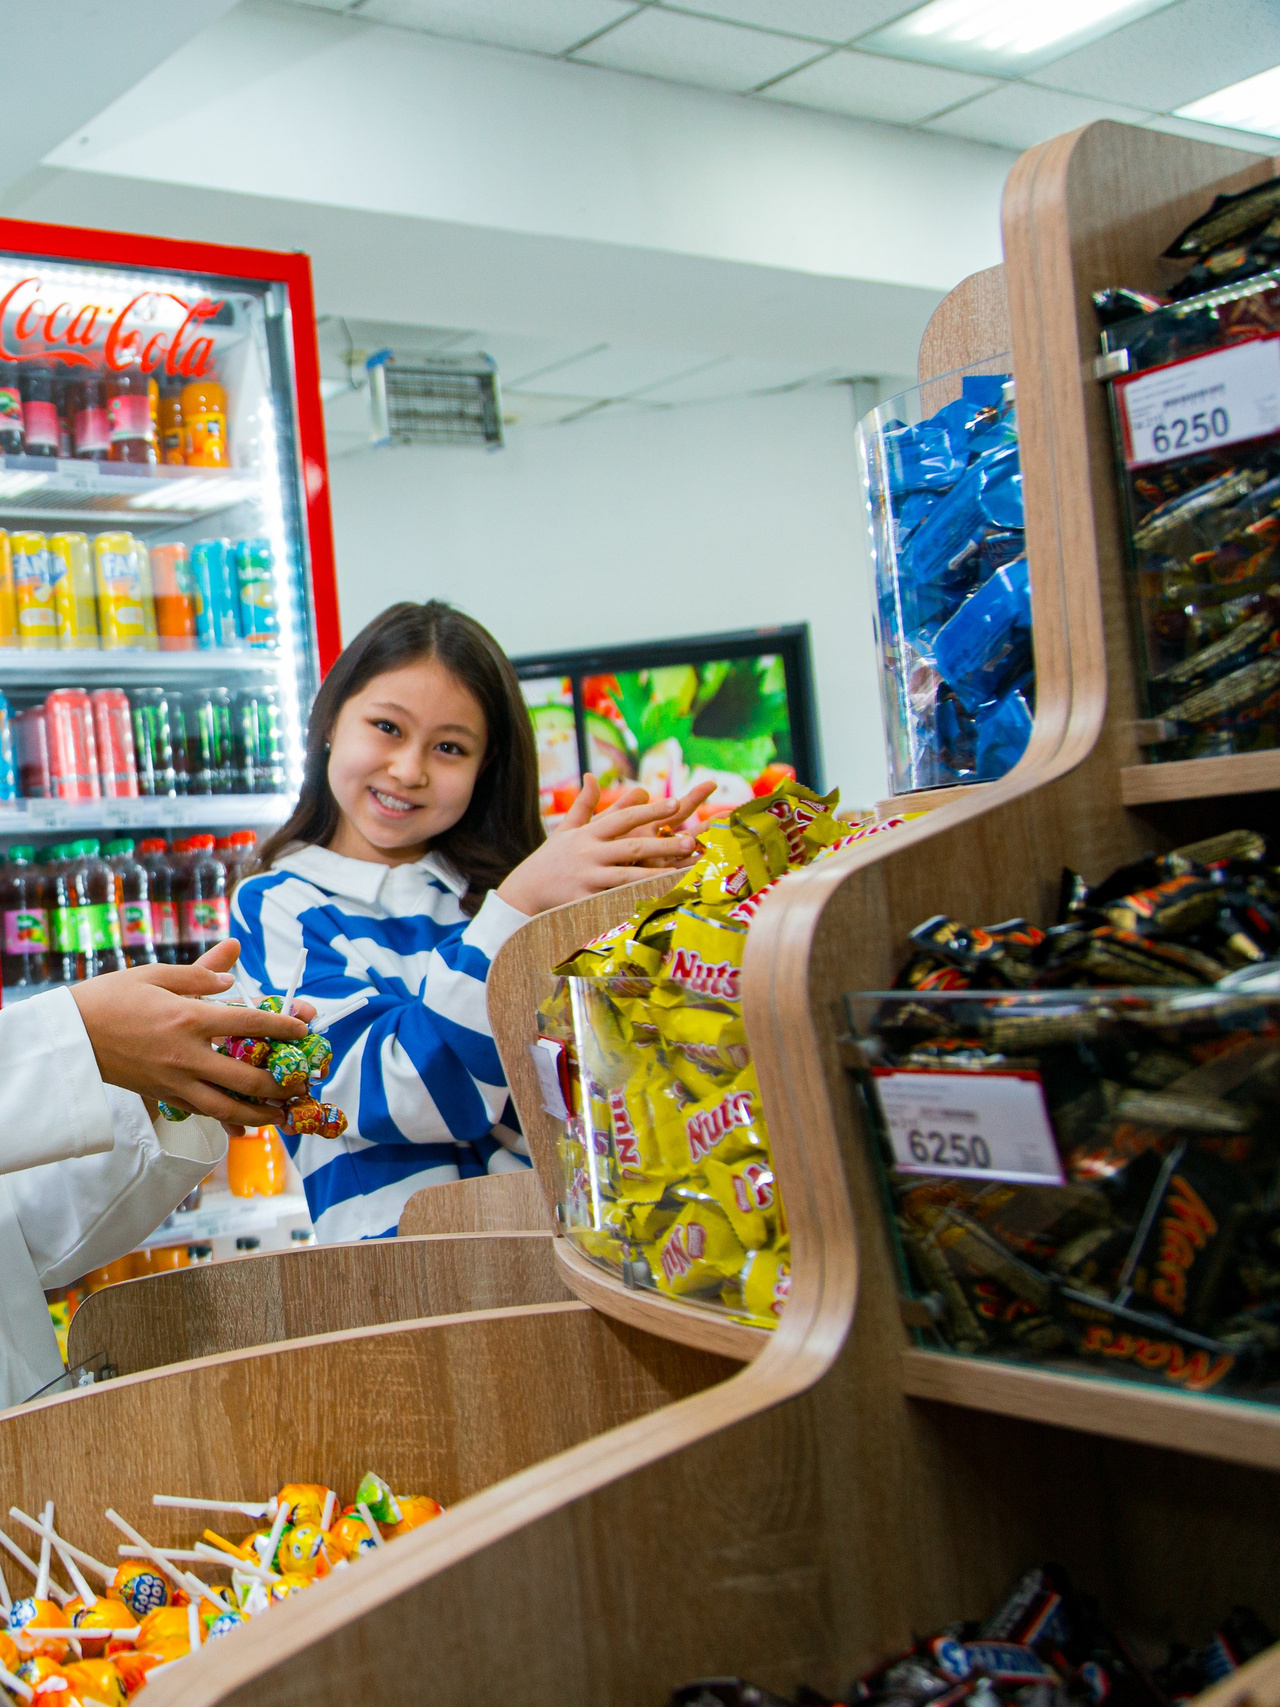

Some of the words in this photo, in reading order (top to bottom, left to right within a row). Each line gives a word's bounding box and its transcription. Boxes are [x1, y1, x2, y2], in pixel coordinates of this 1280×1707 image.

[1153, 406, 1230, 454] 6250
[672, 947, 742, 1001] Nuts
[686, 1090, 755, 1163] Nuts
[908, 1129, 992, 1169] 6250
[1154, 1175, 1217, 1315] Mars
[1082, 1325, 1236, 1391] Mars
